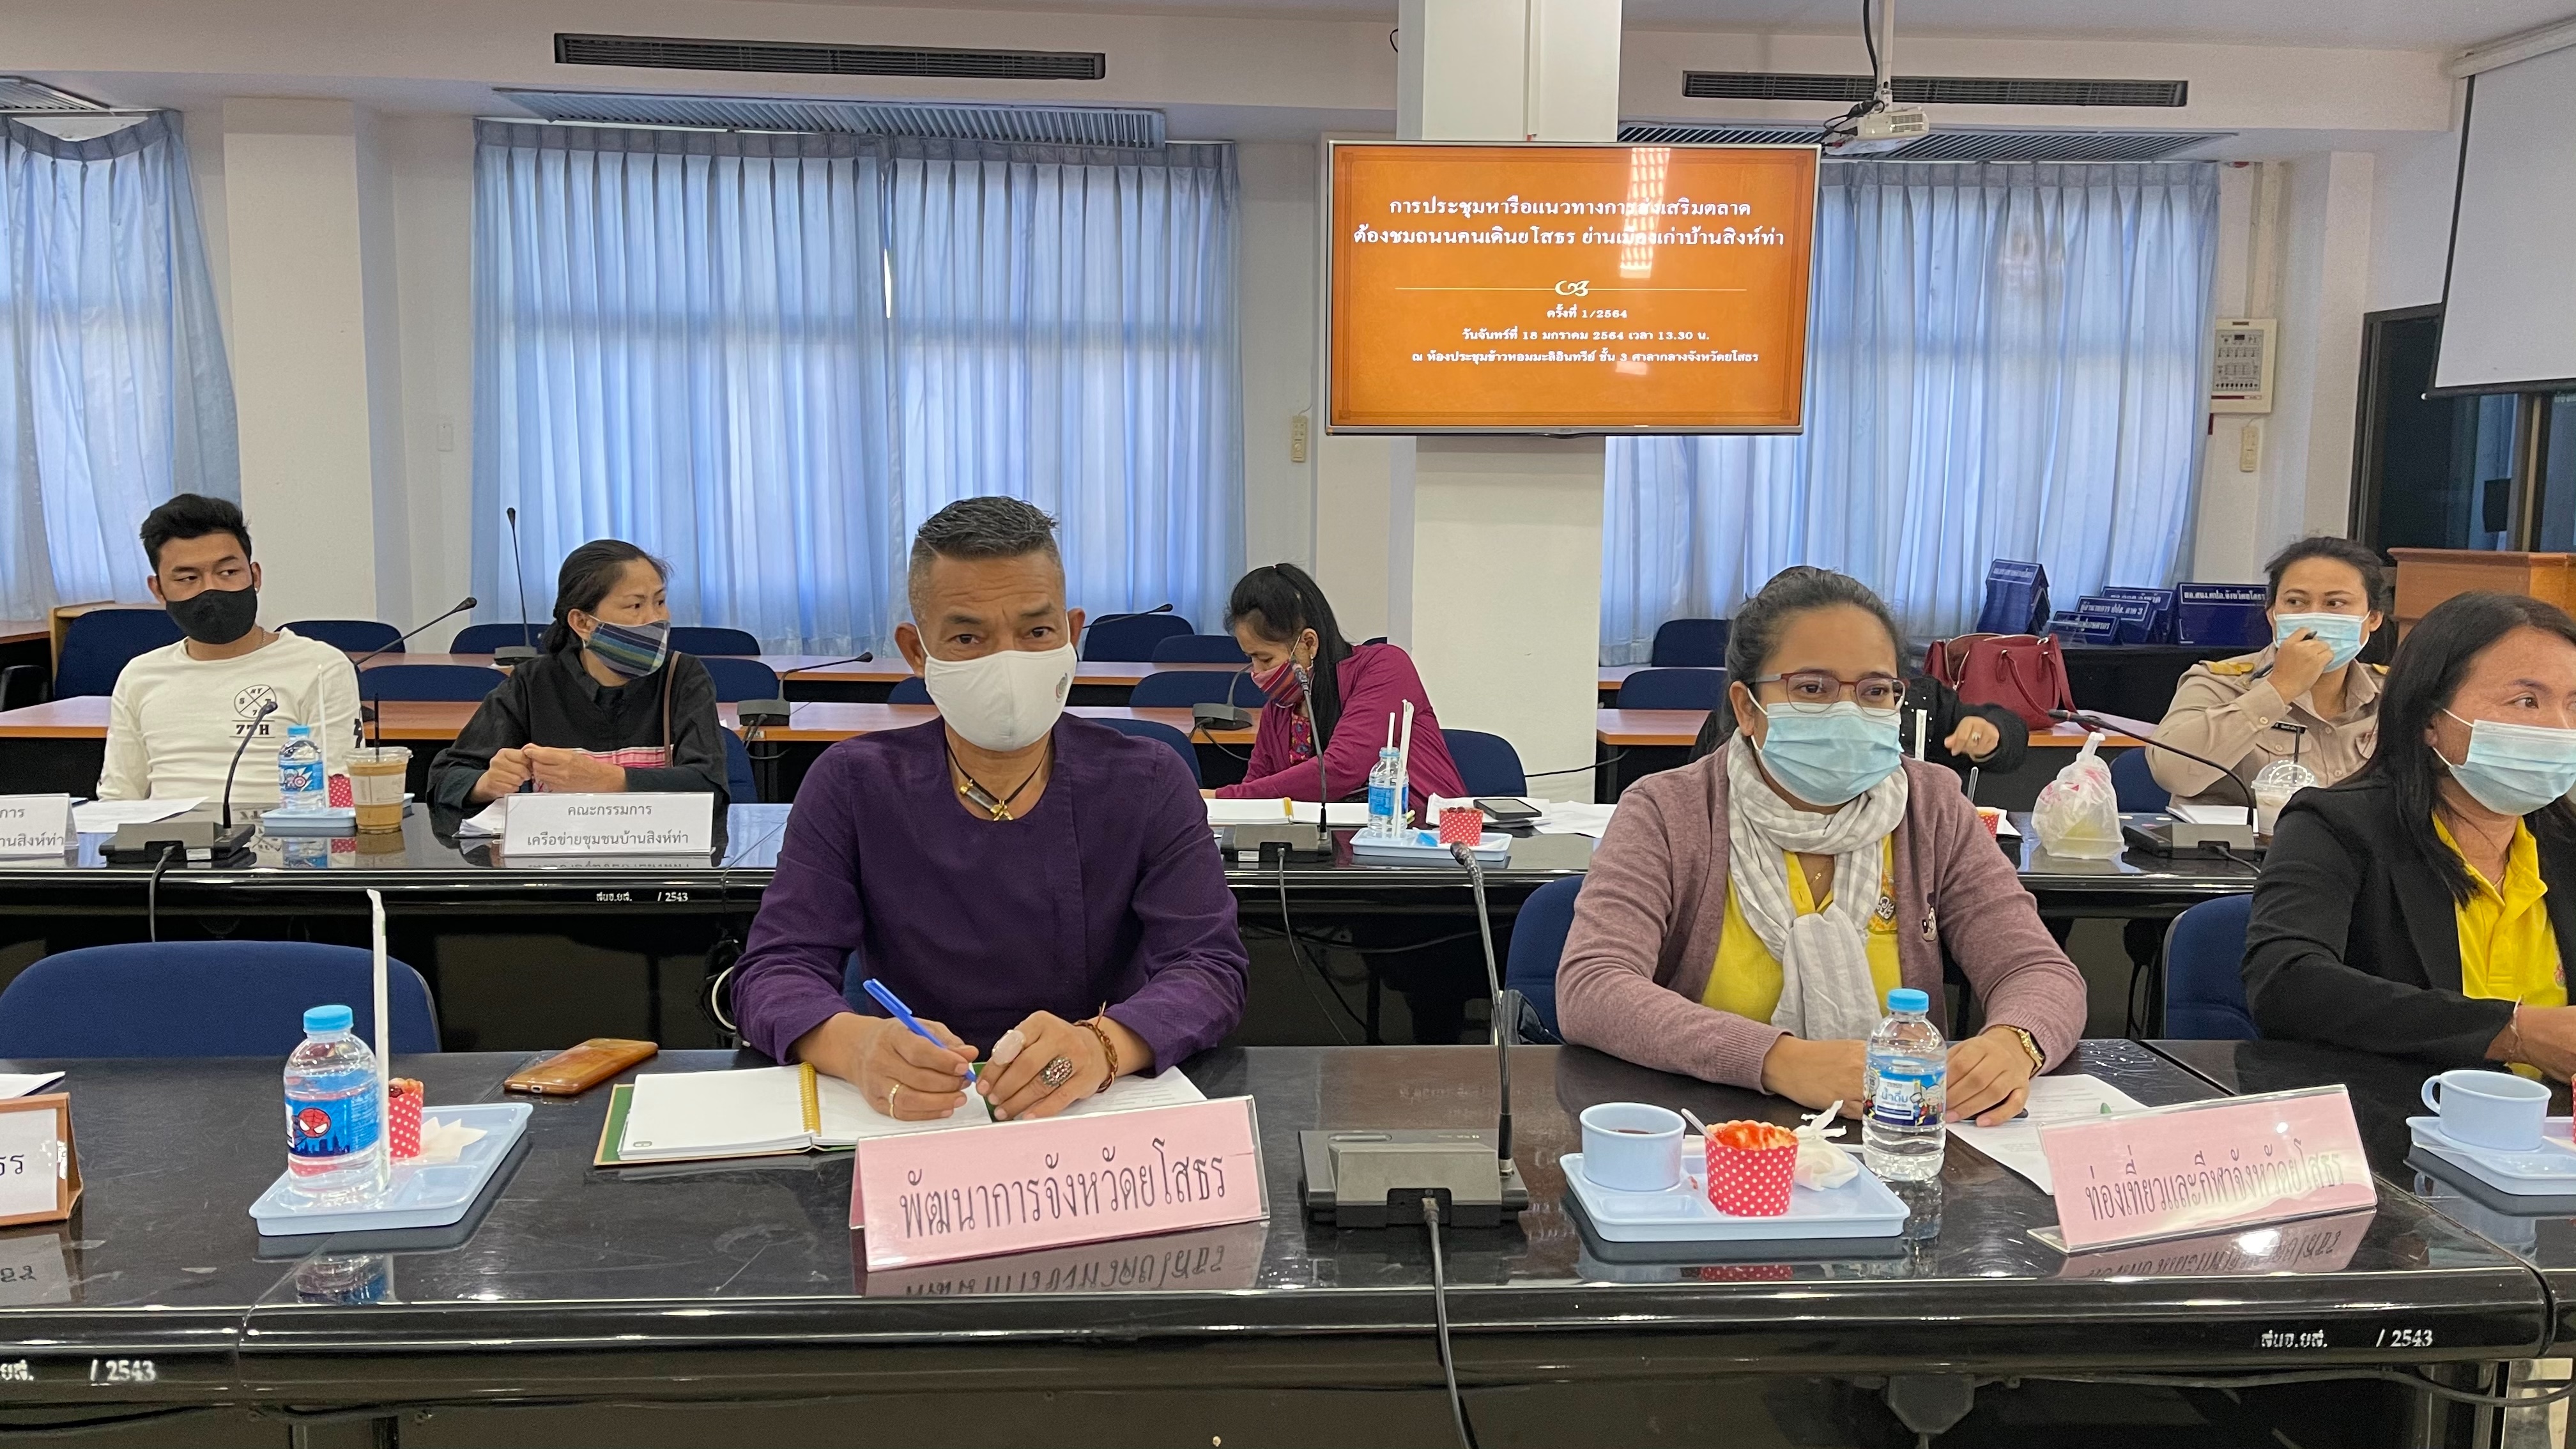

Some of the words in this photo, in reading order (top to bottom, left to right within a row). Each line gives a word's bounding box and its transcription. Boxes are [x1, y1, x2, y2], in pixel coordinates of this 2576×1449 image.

[1353, 224, 1575, 245] ต้องชมถนนคนเดินยโสธร
[1582, 226, 1784, 246] ย่านเมืองเก่าบ้านสิงห์ท่า
[1547, 304, 1577, 318] ครั้งที่
[1582, 309, 1628, 318] 1/2564
[1462, 326, 1518, 340] วันจันทร์ที่
[1522, 331, 1538, 340] 18
[1542, 331, 1588, 340] มกราคม
[1593, 331, 1624, 340] 2564
[1629, 332, 1653, 340] เวลา
[1658, 332, 1693, 341] 13.30
[1698, 332, 1710, 341] น.
[1412, 353, 1423, 362] ณ
[1600, 347, 1615, 362] ชั้น
[1620, 353, 1627, 362] 3
[1632, 350, 1759, 362] ศาลากลางจังหวัดยโสธร
[567, 803, 652, 816] คณะกรรมการ
[527, 829, 689, 849] เครือข่ายชุมชนบ้านสิงห์ท่า
[665, 893, 689, 901] 2543
[900, 1138, 1226, 1238] พัฒนาการจังหวัดยโสธร
[2085, 1138, 2345, 1221] ท่องเที่ยวและกีฬาจังหวัดยโสธร
[2390, 1330, 2433, 1347] 2543
[105, 1360, 157, 1381] 2543
